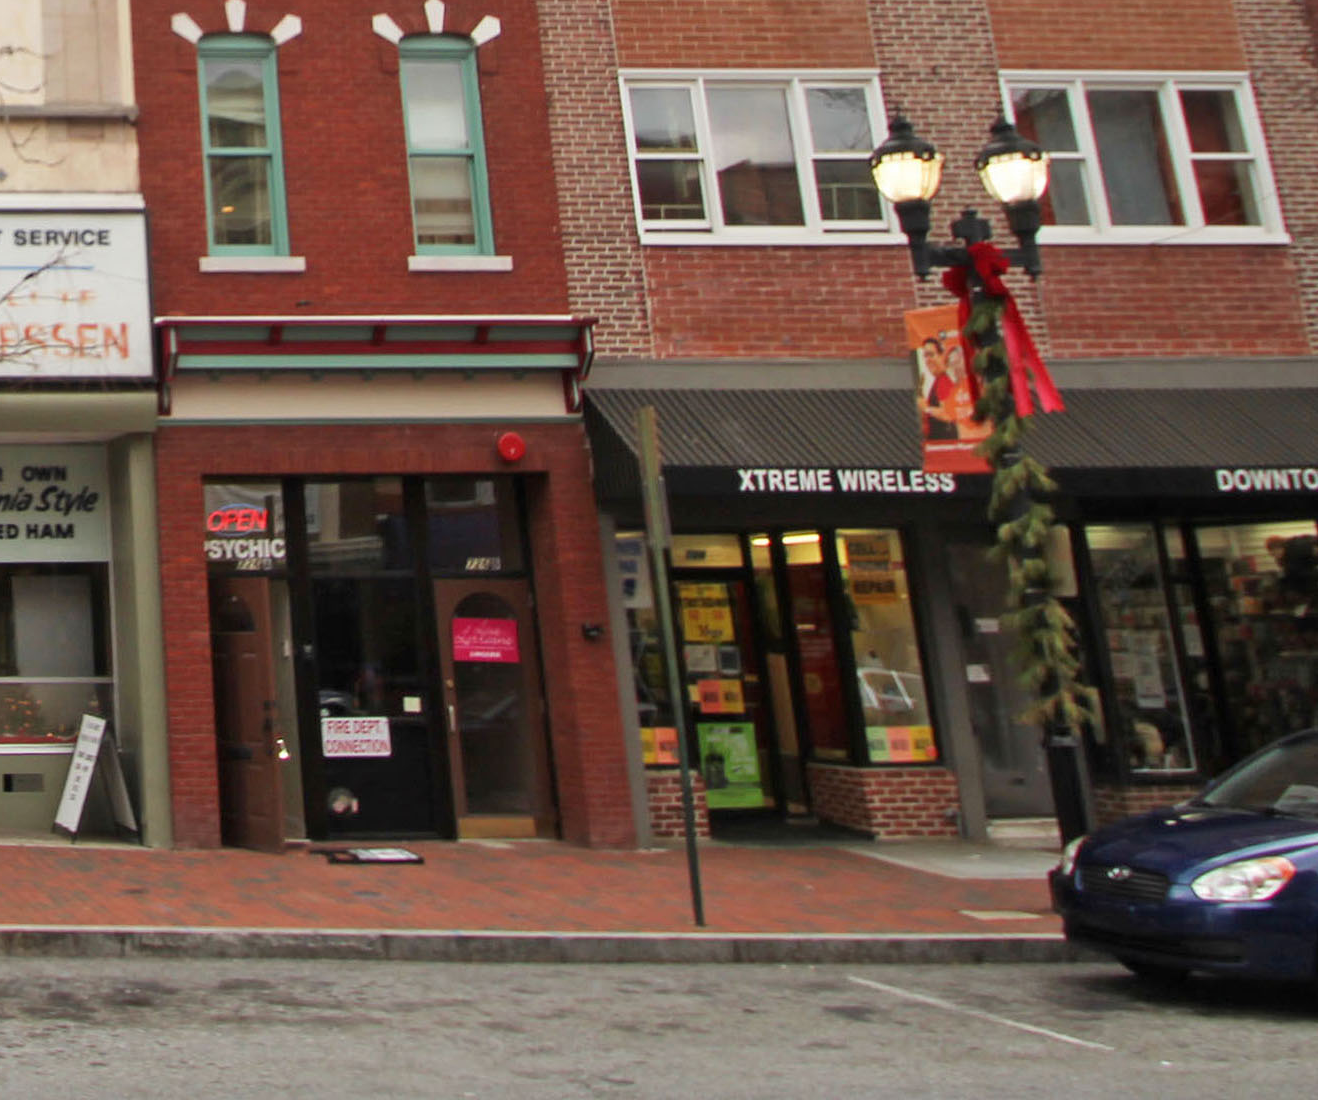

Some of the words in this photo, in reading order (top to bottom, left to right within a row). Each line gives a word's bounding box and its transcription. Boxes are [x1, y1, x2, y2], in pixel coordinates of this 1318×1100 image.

[13, 229, 112, 246] SERVICE
[21, 466, 67, 482] OWN
[738, 468, 832, 492] XTREME
[837, 469, 957, 493] WIRELESS
[1215, 468, 1318, 492] DOWNTO
[34, 484, 99, 517] Style
[206, 508, 269, 532] OPEN
[26, 523, 75, 540] HAM
[327, 720, 350, 734] FIRE
